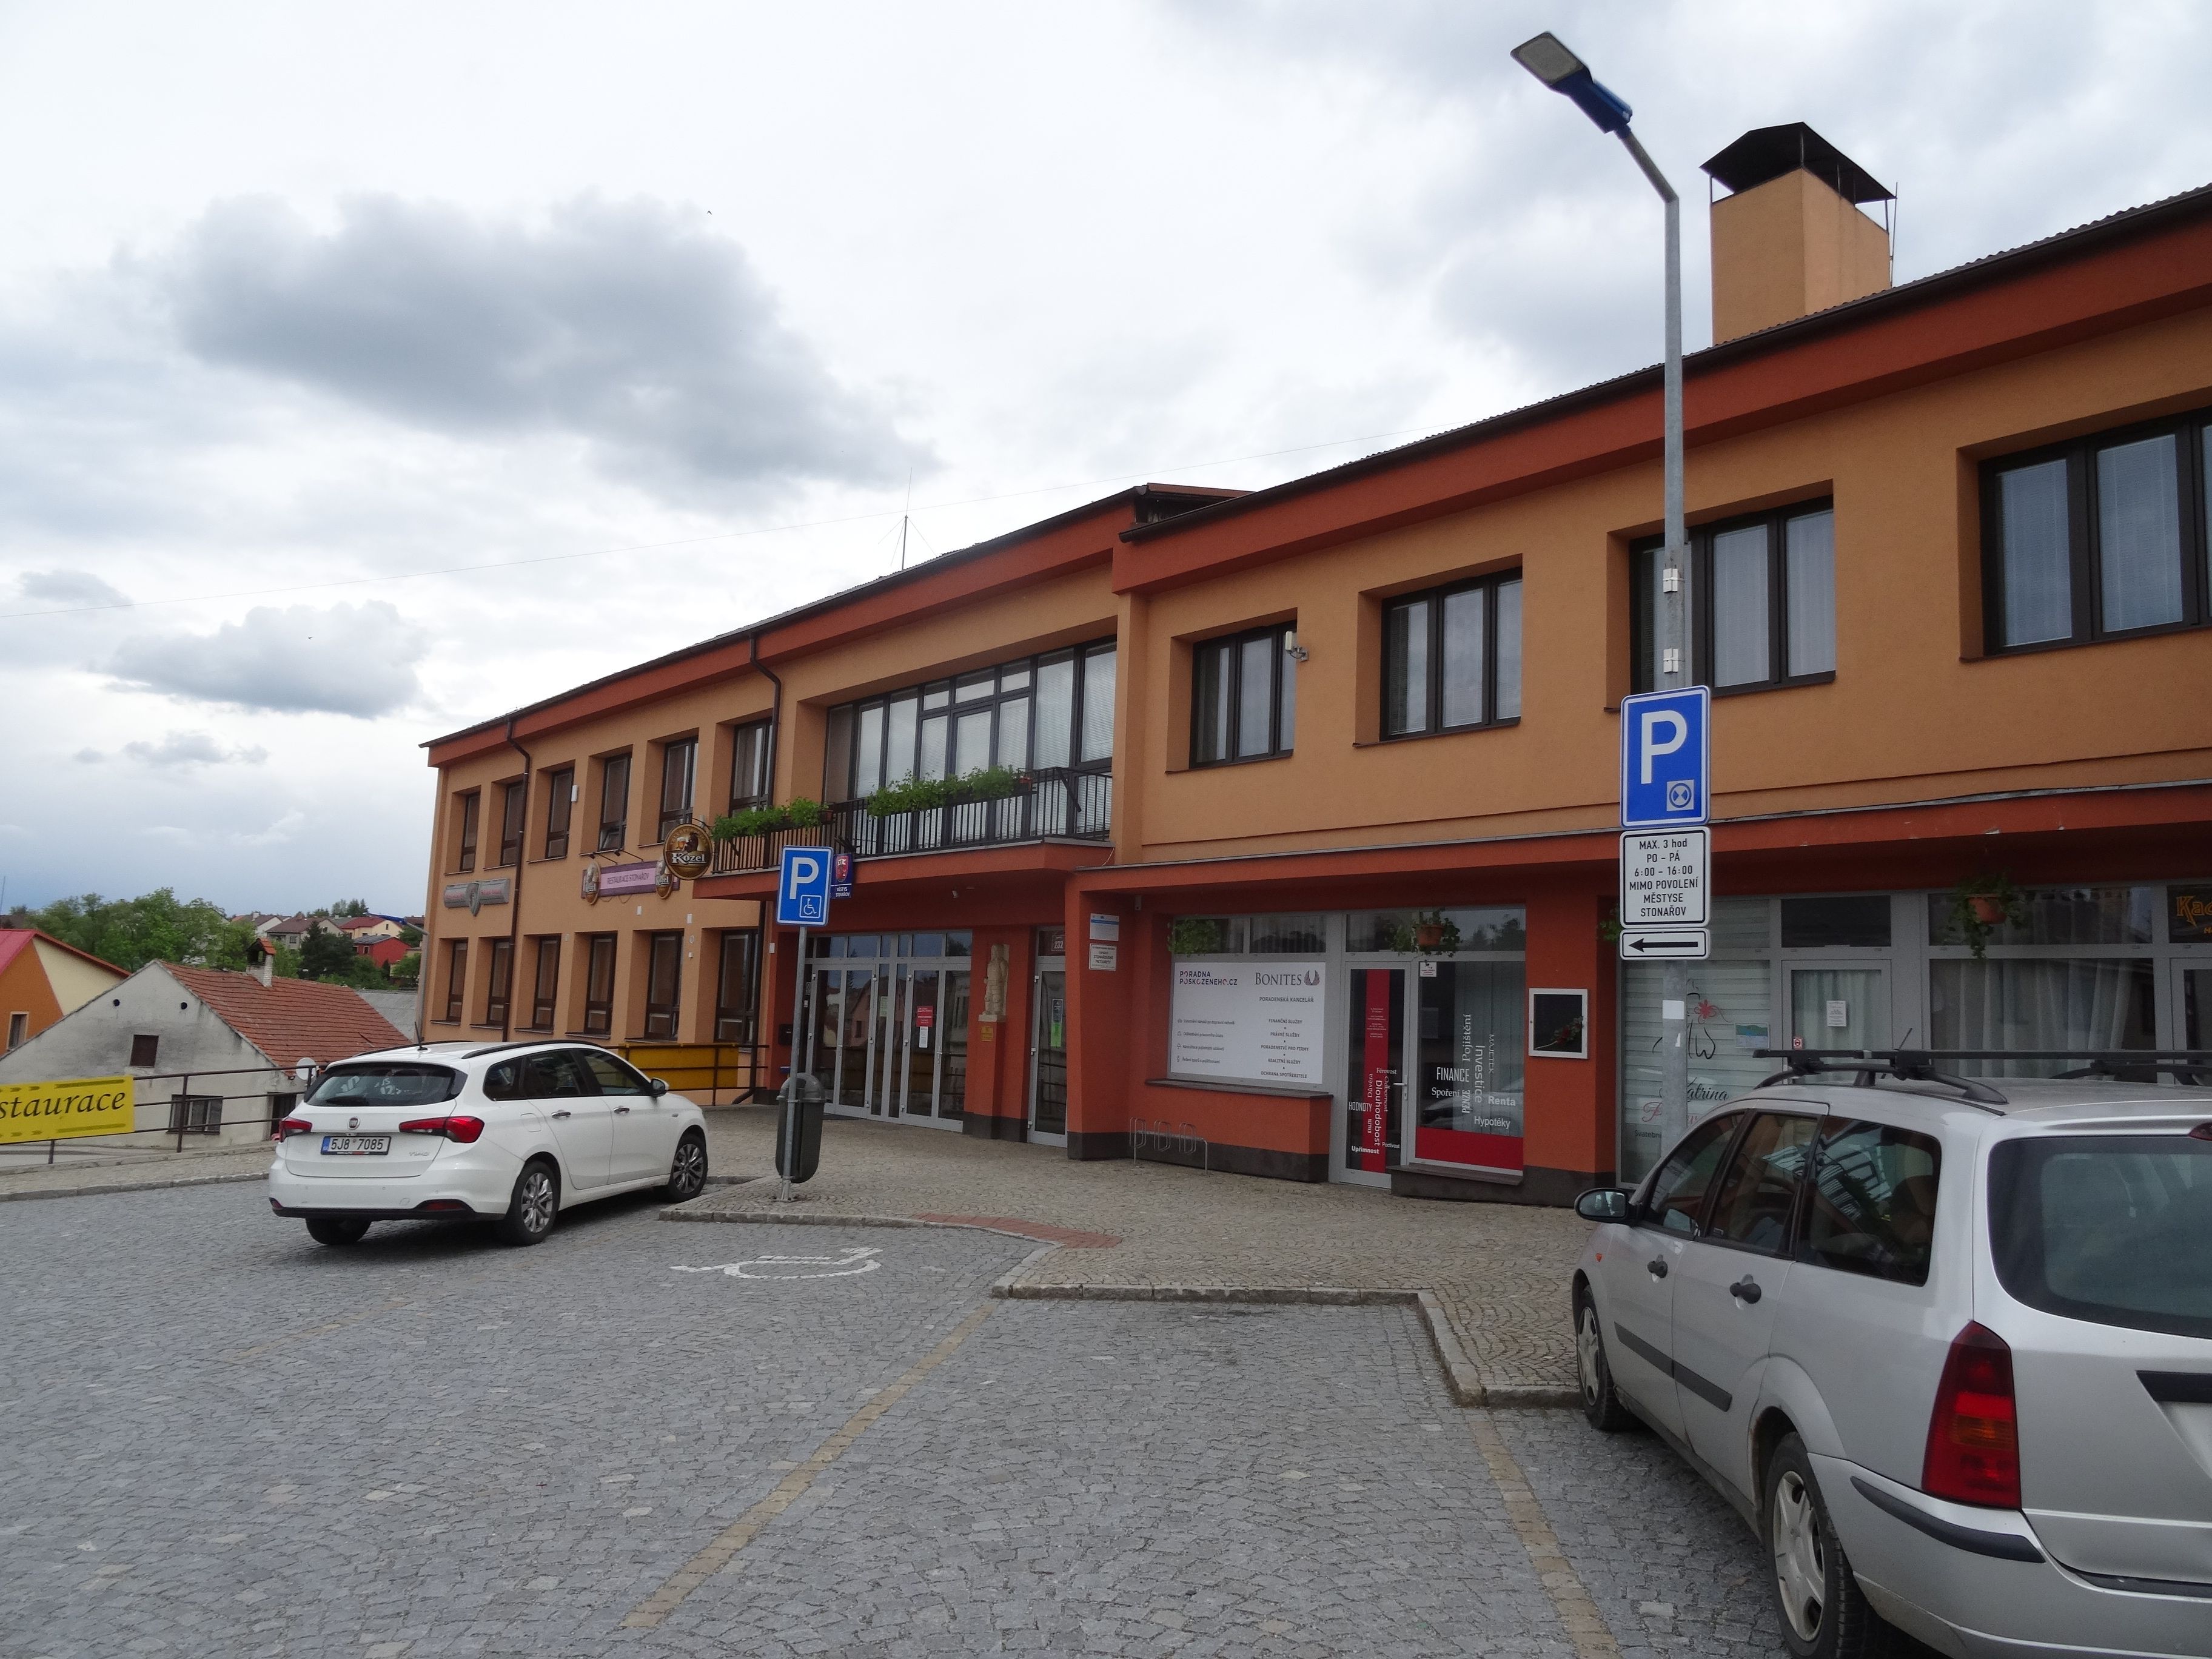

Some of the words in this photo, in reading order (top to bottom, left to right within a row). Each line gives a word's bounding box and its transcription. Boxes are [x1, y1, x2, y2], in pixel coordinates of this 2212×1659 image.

[1641, 710, 1687, 785] P
[1639, 840, 1660, 850] MAX.
[1663, 839, 1668, 848] 3
[1672, 838, 1687, 848] hod
[672, 852, 707, 865] Kozel
[1647, 854, 1657, 863] PO
[1669, 850, 1680, 862] PÁ
[1634, 867, 1655, 877] 6:00
[1667, 865, 1692, 875] 16:00
[789, 857, 819, 900] P
[1629, 881, 1652, 890] MIMO
[1656, 876, 1698, 889] POVOLENÍ
[1643, 892, 1683, 903] MĚSTYSE
[1640, 905, 1686, 917] STONAŘOV
[1255, 972, 1302, 986] BONITES
[1462, 1014, 1473, 1062] Pojištění
[1436, 1067, 1470, 1082] FINANCE
[1474, 1045, 1486, 1104] Investice
[1432, 1087, 1460, 1098] Spoření
[0, 1091, 126, 1119] staurace
[1349, 1101, 1372, 1112] HODNOTY
[1488, 1096, 1516, 1107] Renta
[1374, 1080, 1382, 1147] Dlouhodobost
[1474, 1116, 1511, 1130] Hypotéky
[331, 1139, 350, 1150] 5J8
[357, 1138, 384, 1150] 7085
[1351, 1145, 1380, 1155] Upřímnost
